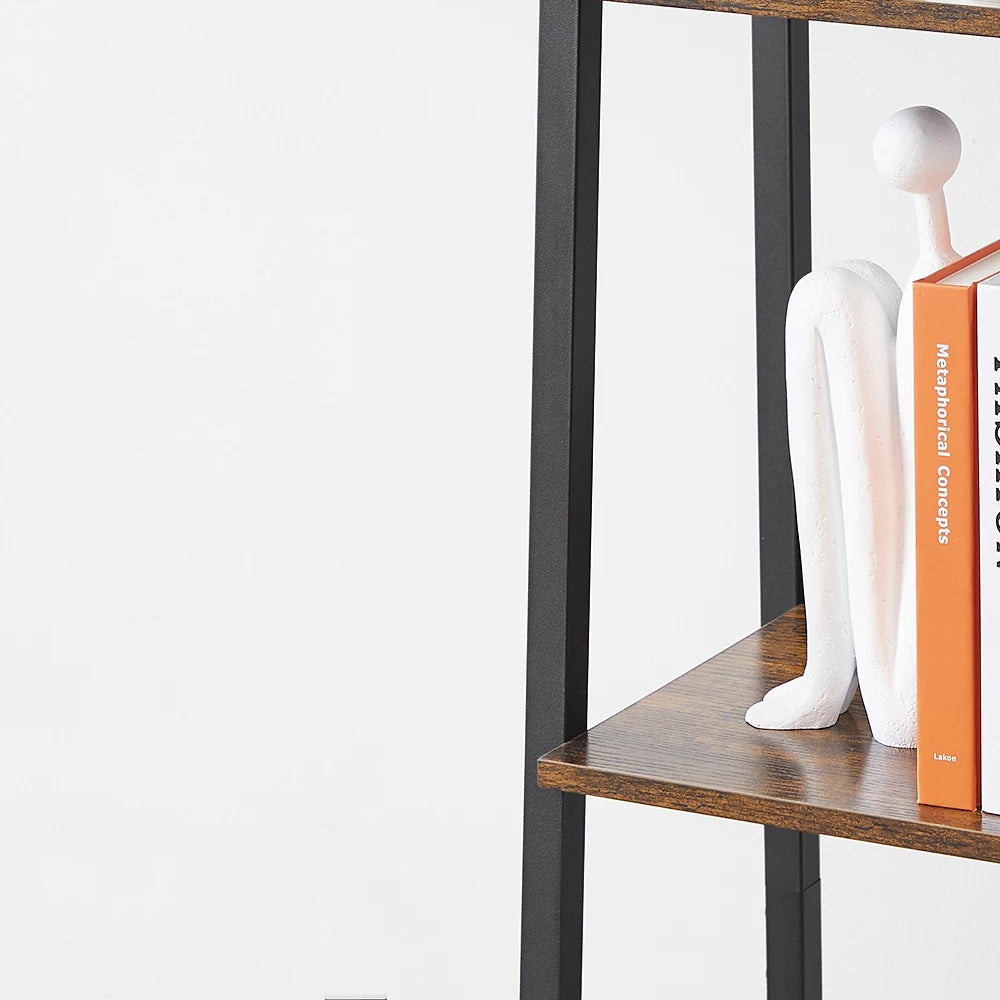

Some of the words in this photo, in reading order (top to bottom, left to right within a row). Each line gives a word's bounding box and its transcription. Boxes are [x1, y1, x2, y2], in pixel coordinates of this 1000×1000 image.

[933, 343, 951, 458] Metaphorical
[936, 464, 951, 546] Concepts
[933, 752, 957, 763] Lakon
